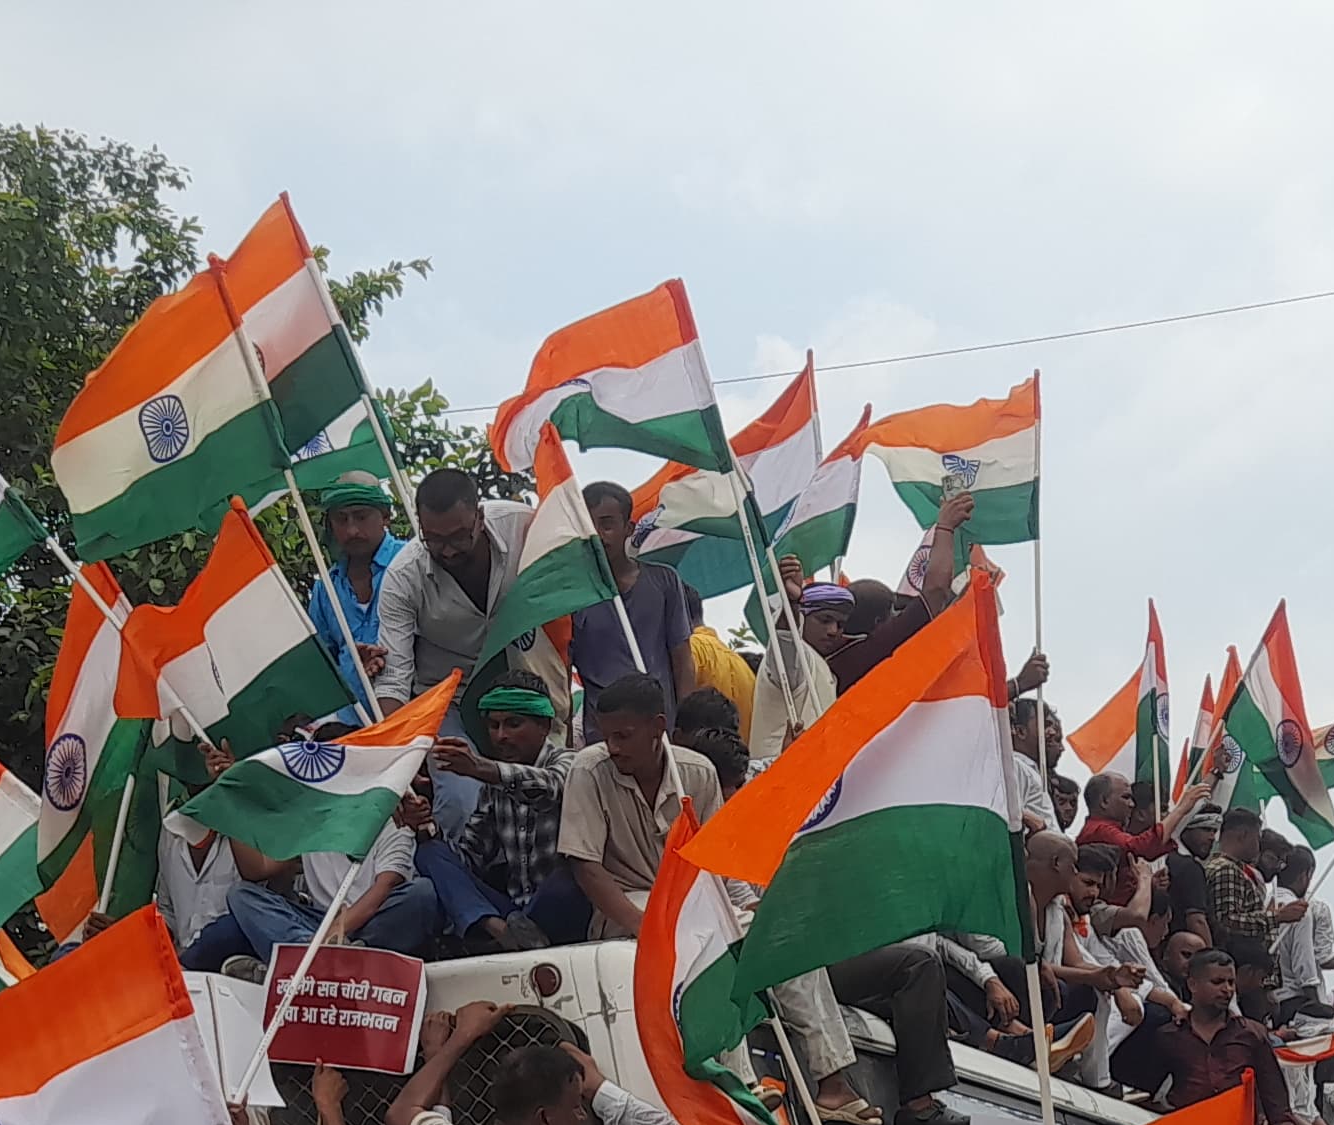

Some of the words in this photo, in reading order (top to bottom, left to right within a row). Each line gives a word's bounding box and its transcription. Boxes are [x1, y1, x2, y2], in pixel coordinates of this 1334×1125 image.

[317, 981, 339, 998] सब
[341, 978, 371, 1001] चोरी
[371, 985, 409, 1007] गबन
[301, 1006, 318, 1024] आ
[319, 1004, 338, 1025] रहे
[338, 1009, 401, 1033] राजभवन
